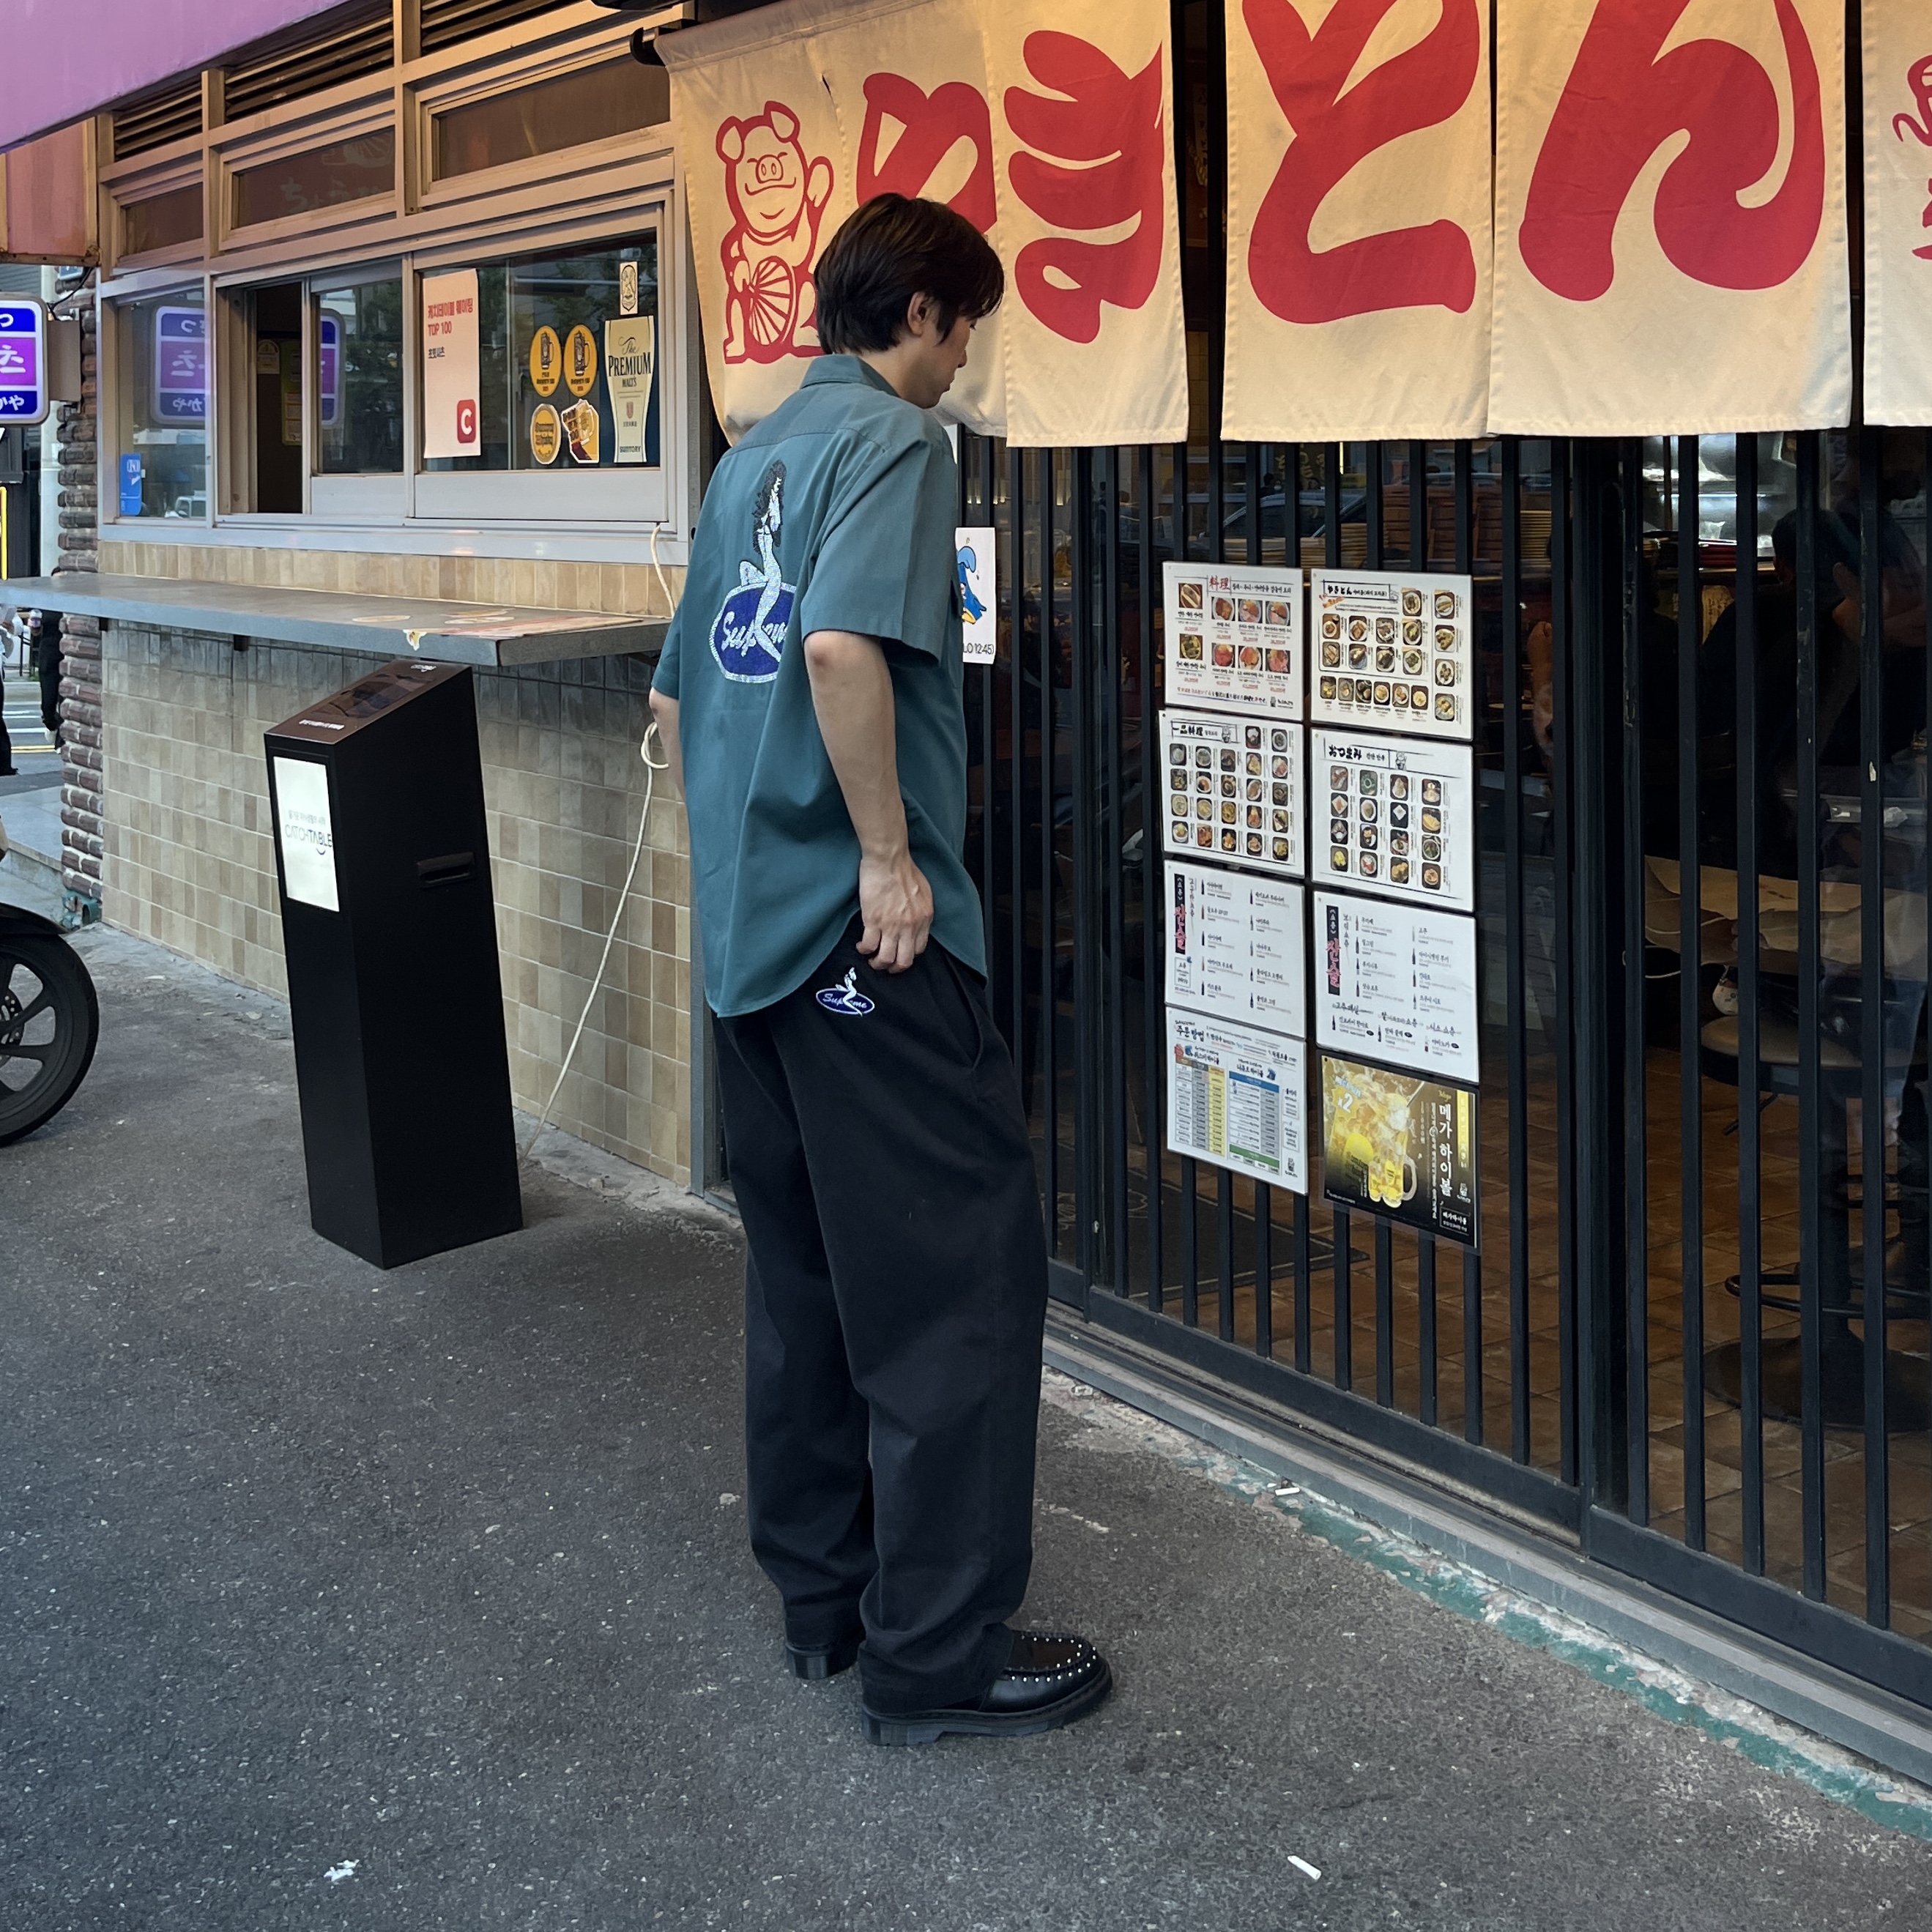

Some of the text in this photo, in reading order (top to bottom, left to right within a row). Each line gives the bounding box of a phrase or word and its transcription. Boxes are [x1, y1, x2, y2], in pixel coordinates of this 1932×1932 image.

[428, 321, 453, 336] TOP 100
[608, 352, 651, 377] PREMIUM
[721, 611, 789, 657] Supem
[974, 642, 995, 655] 12:45)
[1329, 744, 1362, 760] おつまみ
[822, 992, 867, 1009] Supme
[1439, 1103, 1454, 1197] 메가 하이볼
